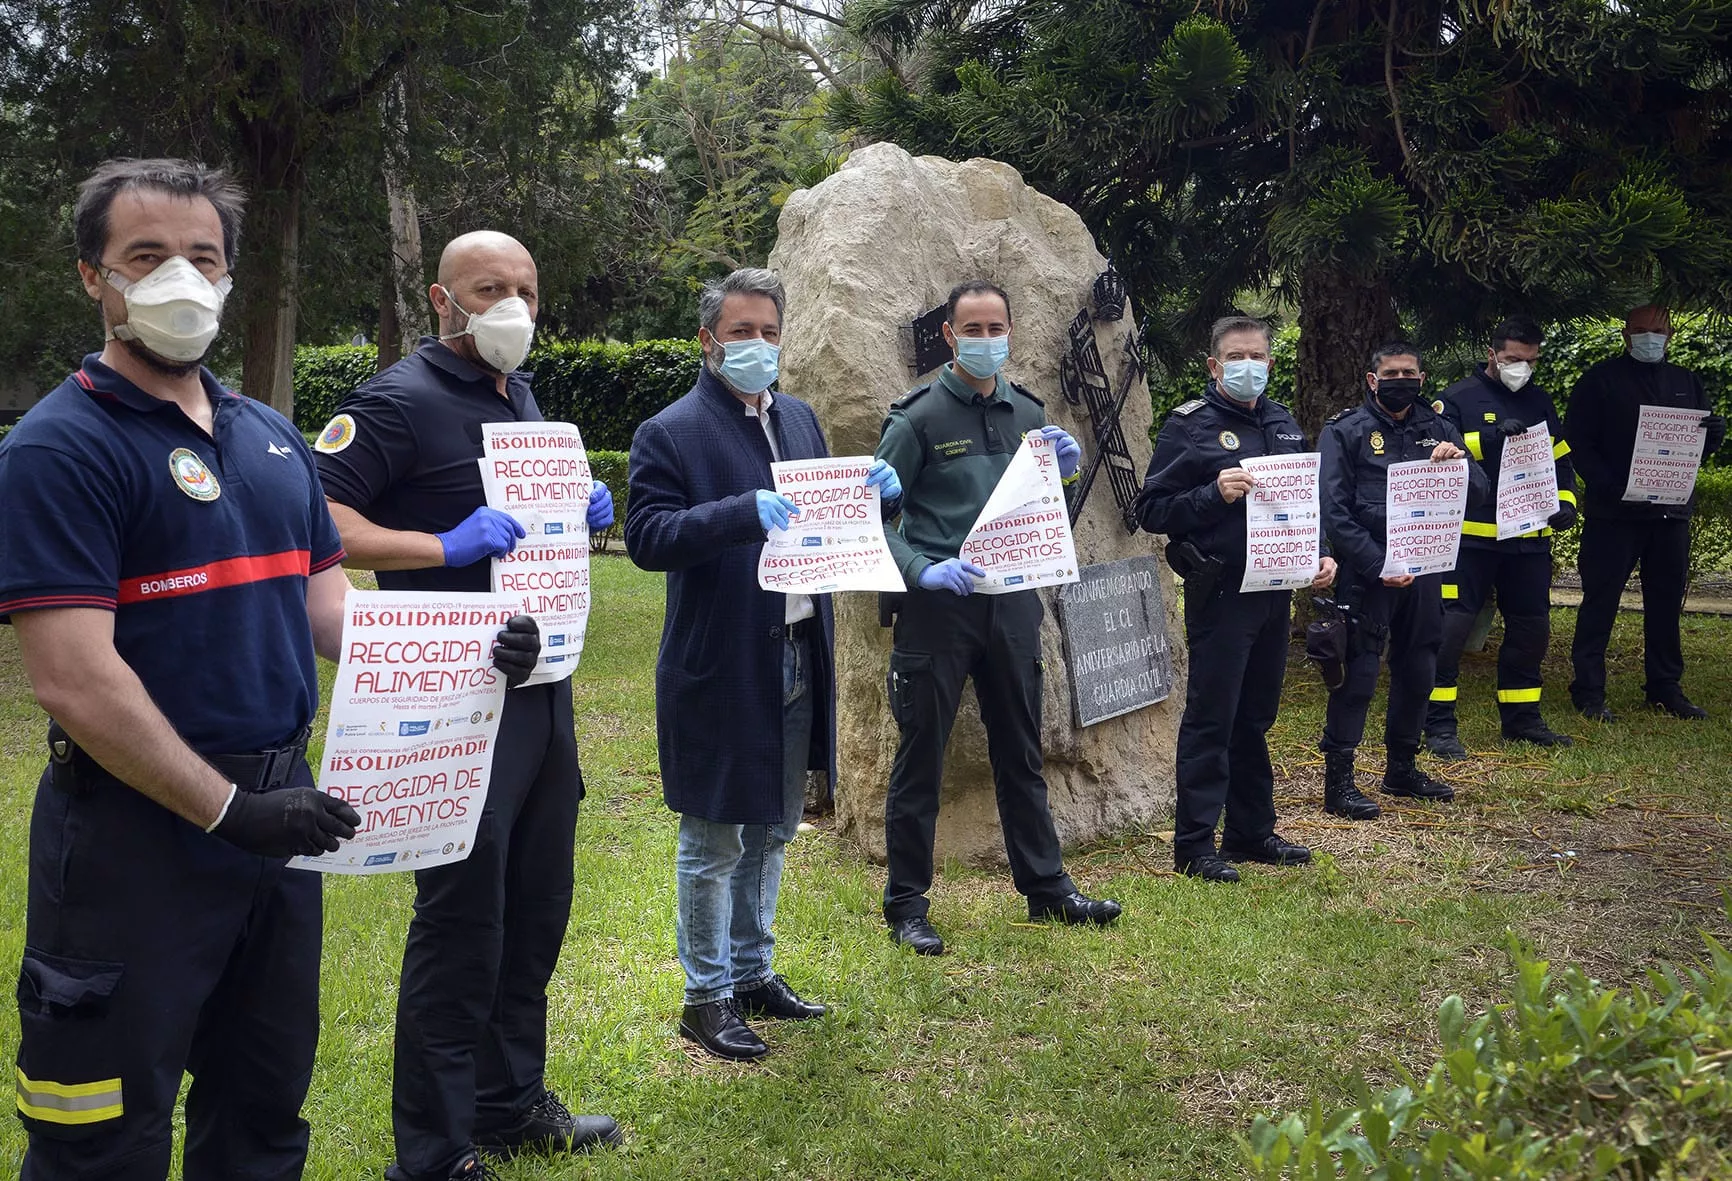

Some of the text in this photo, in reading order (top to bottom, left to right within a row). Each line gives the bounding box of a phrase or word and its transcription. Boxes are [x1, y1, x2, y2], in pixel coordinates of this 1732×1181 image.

[1640, 420, 1689, 432] RECOGIDA
[1643, 431, 1698, 444] ALIMENTOS
[494, 459, 578, 478] RECOGIDA
[1632, 467, 1694, 480] RECOGIDA DE
[1304, 474, 1316, 486] DE
[1390, 476, 1464, 492] RECOGIDA DE
[1634, 478, 1688, 490] ALIMENTOS
[505, 482, 589, 502] ALIMENTOS
[853, 486, 874, 500] DE
[1254, 488, 1312, 502] ALIMENTOS
[1394, 489, 1459, 503] ALIMENTOS
[1499, 488, 1556, 510] RECOGIDA DE
[1502, 499, 1554, 520] ALIMENTOS
[963, 526, 1066, 554] RECOGIDA DE
[1250, 540, 1317, 556] RECOGIDA DE
[1390, 532, 1458, 548] RECOGIDA DE
[971, 542, 1062, 567] ALIMENTOS
[1254, 554, 1313, 568] ALIMENTOS
[1392, 543, 1452, 560] ALIMENTOS
[140, 572, 208, 594] BOMBEROS
[501, 570, 580, 592] RECOGIDA
[1073, 570, 1152, 603] CONMEMORANDO
[1104, 608, 1133, 632] EL CL
[348, 640, 482, 665] RECOGIDA
[1076, 632, 1168, 676] ANIVERSARIO DE LA
[355, 665, 497, 694] ALIMENTOS
[1094, 668, 1162, 706] GUARDIA CIVIL
[455, 768, 483, 791] DE
